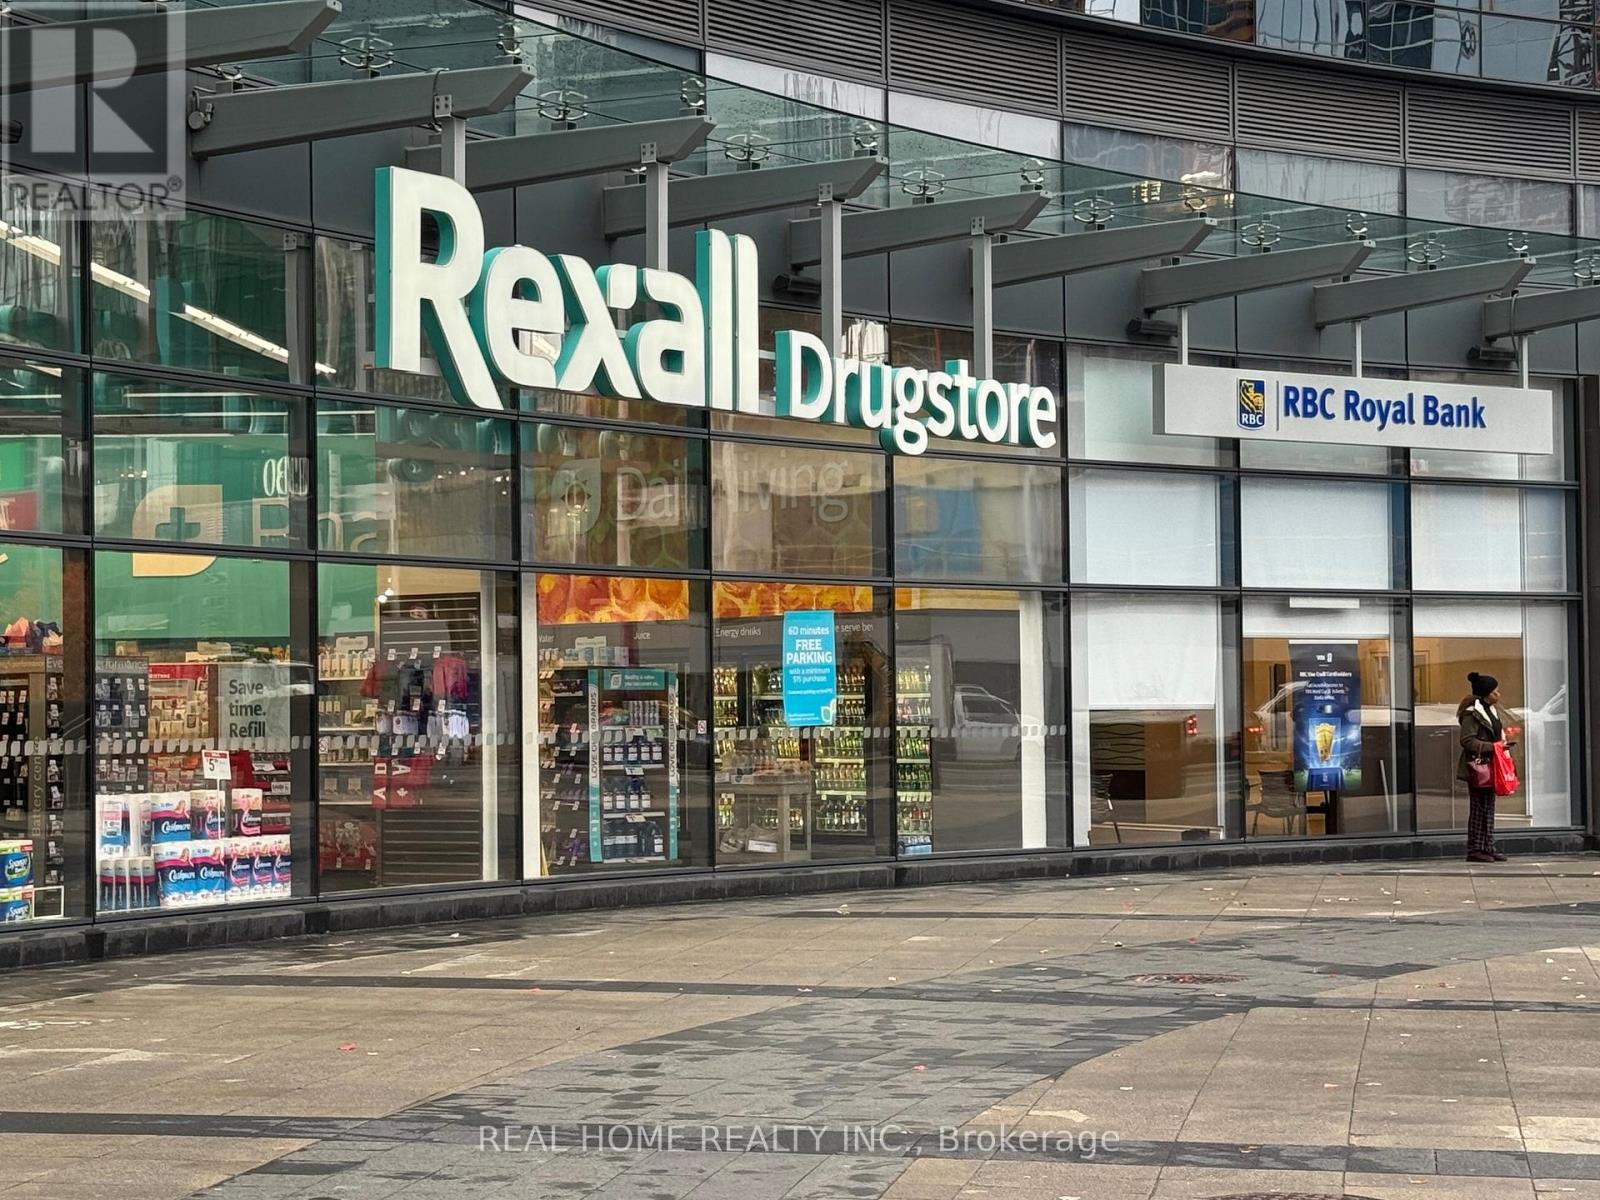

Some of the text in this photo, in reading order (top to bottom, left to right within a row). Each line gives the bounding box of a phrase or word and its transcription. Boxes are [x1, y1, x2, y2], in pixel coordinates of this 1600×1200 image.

[376, 166, 759, 413] Rexall
[776, 330, 1057, 455] Drugstore
[1283, 385, 1486, 432] RBC Royal Bank
[1241, 413, 1263, 425] RBC
[634, 631, 651, 640] Juice
[714, 625, 761, 639] Energy drinks
[800, 626, 829, 635] minutes
[796, 639, 822, 650] FREE
[786, 651, 832, 664] PARKING
[229, 680, 263, 695] Save
[229, 700, 266, 717] time.
[229, 721, 266, 738] Refill
[32, 785, 43, 837] Battery
